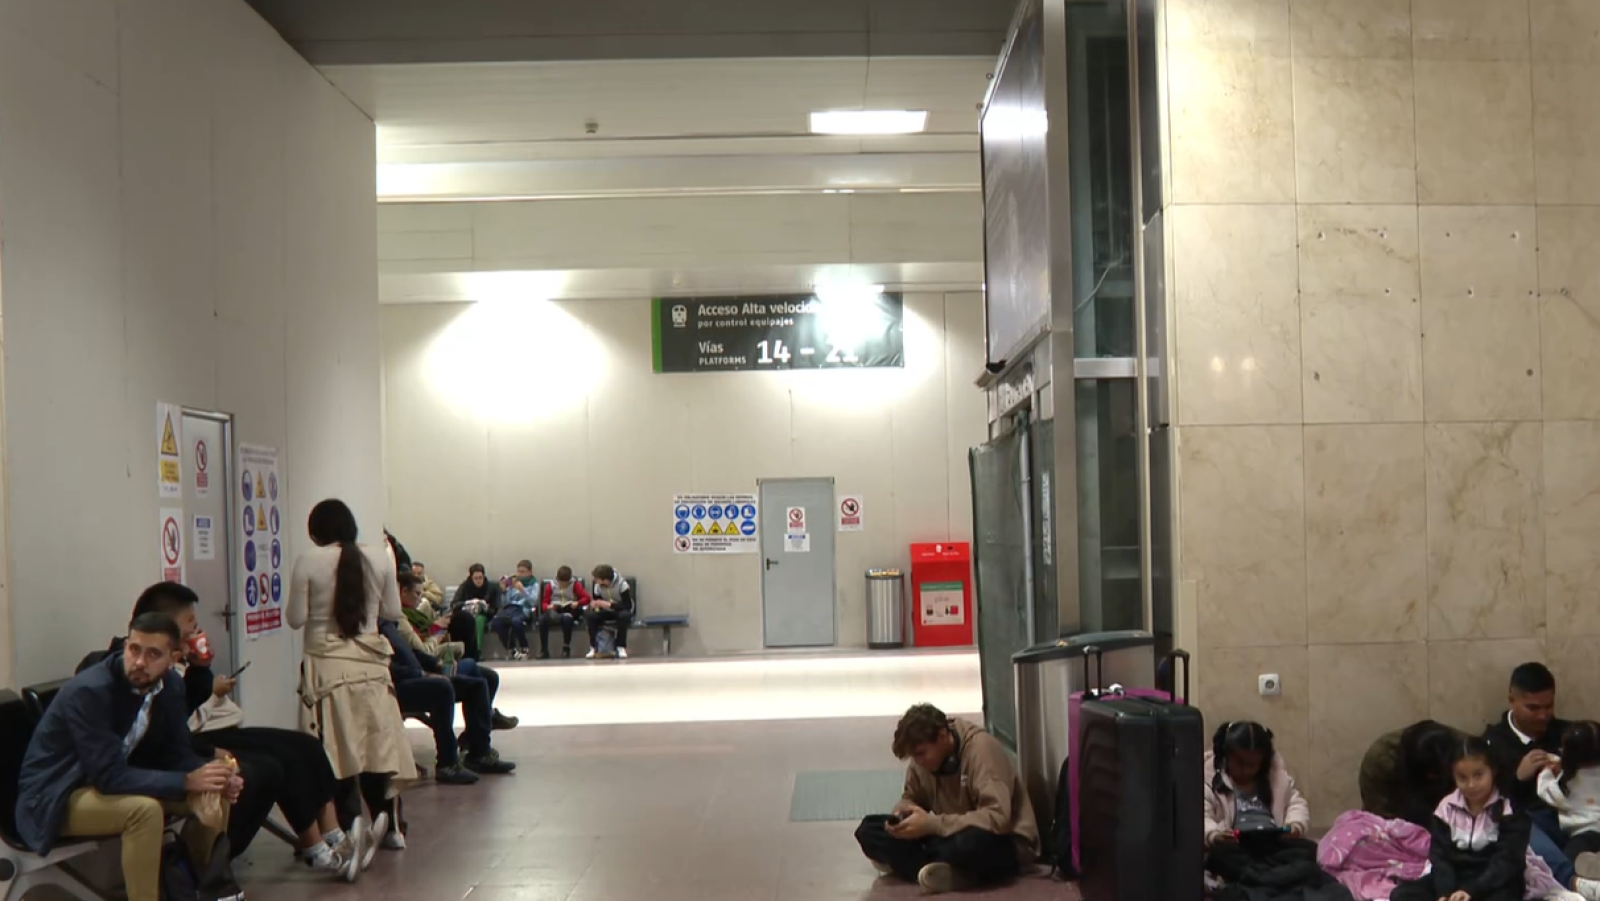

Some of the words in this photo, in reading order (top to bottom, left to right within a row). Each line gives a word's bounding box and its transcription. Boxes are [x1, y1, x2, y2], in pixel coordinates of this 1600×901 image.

[698, 304, 738, 316] Acceso
[742, 302, 766, 315] Alta
[698, 319, 713, 329] por
[715, 318, 747, 327] control
[750, 317, 794, 328] equipajes
[698, 341, 724, 354] Vías
[757, 339, 791, 364] 14
[699, 356, 746, 366] PLATFORMS
